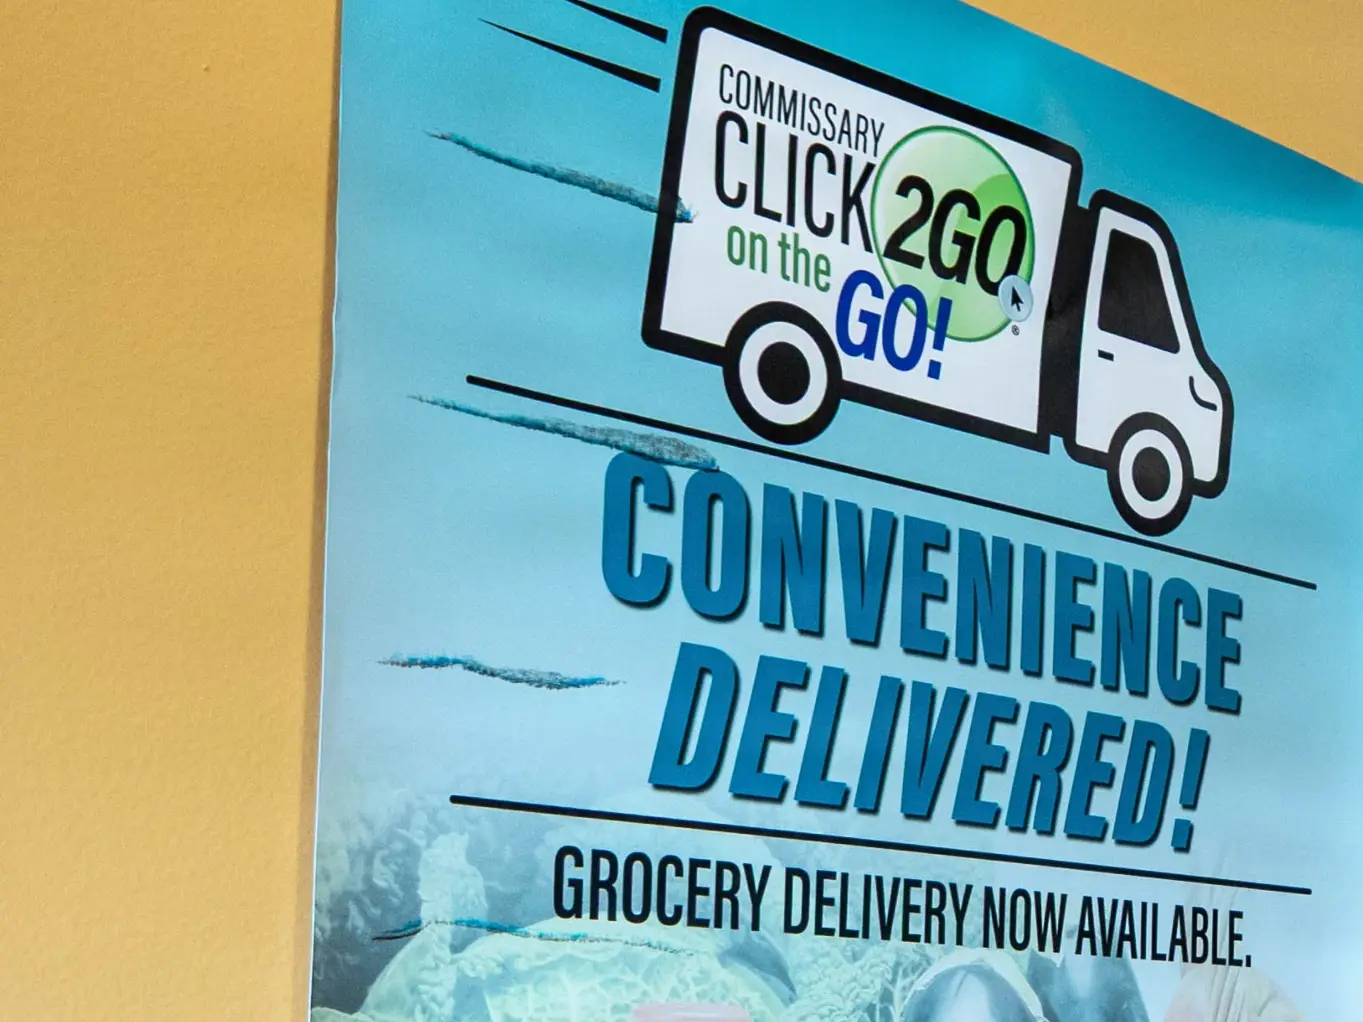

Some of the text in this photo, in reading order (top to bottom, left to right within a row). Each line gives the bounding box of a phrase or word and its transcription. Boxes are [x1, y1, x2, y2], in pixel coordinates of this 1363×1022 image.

[719, 63, 885, 157] COMMISSARY
[714, 110, 1028, 297] CLICK 2GO
[726, 224, 954, 381] on the GO!
[601, 452, 1244, 716] CONVENIENCE
[648, 642, 1211, 852] DELIVERED!
[552, 844, 1254, 968] GROCERY DELIVERY NOW AVAILABLE.
